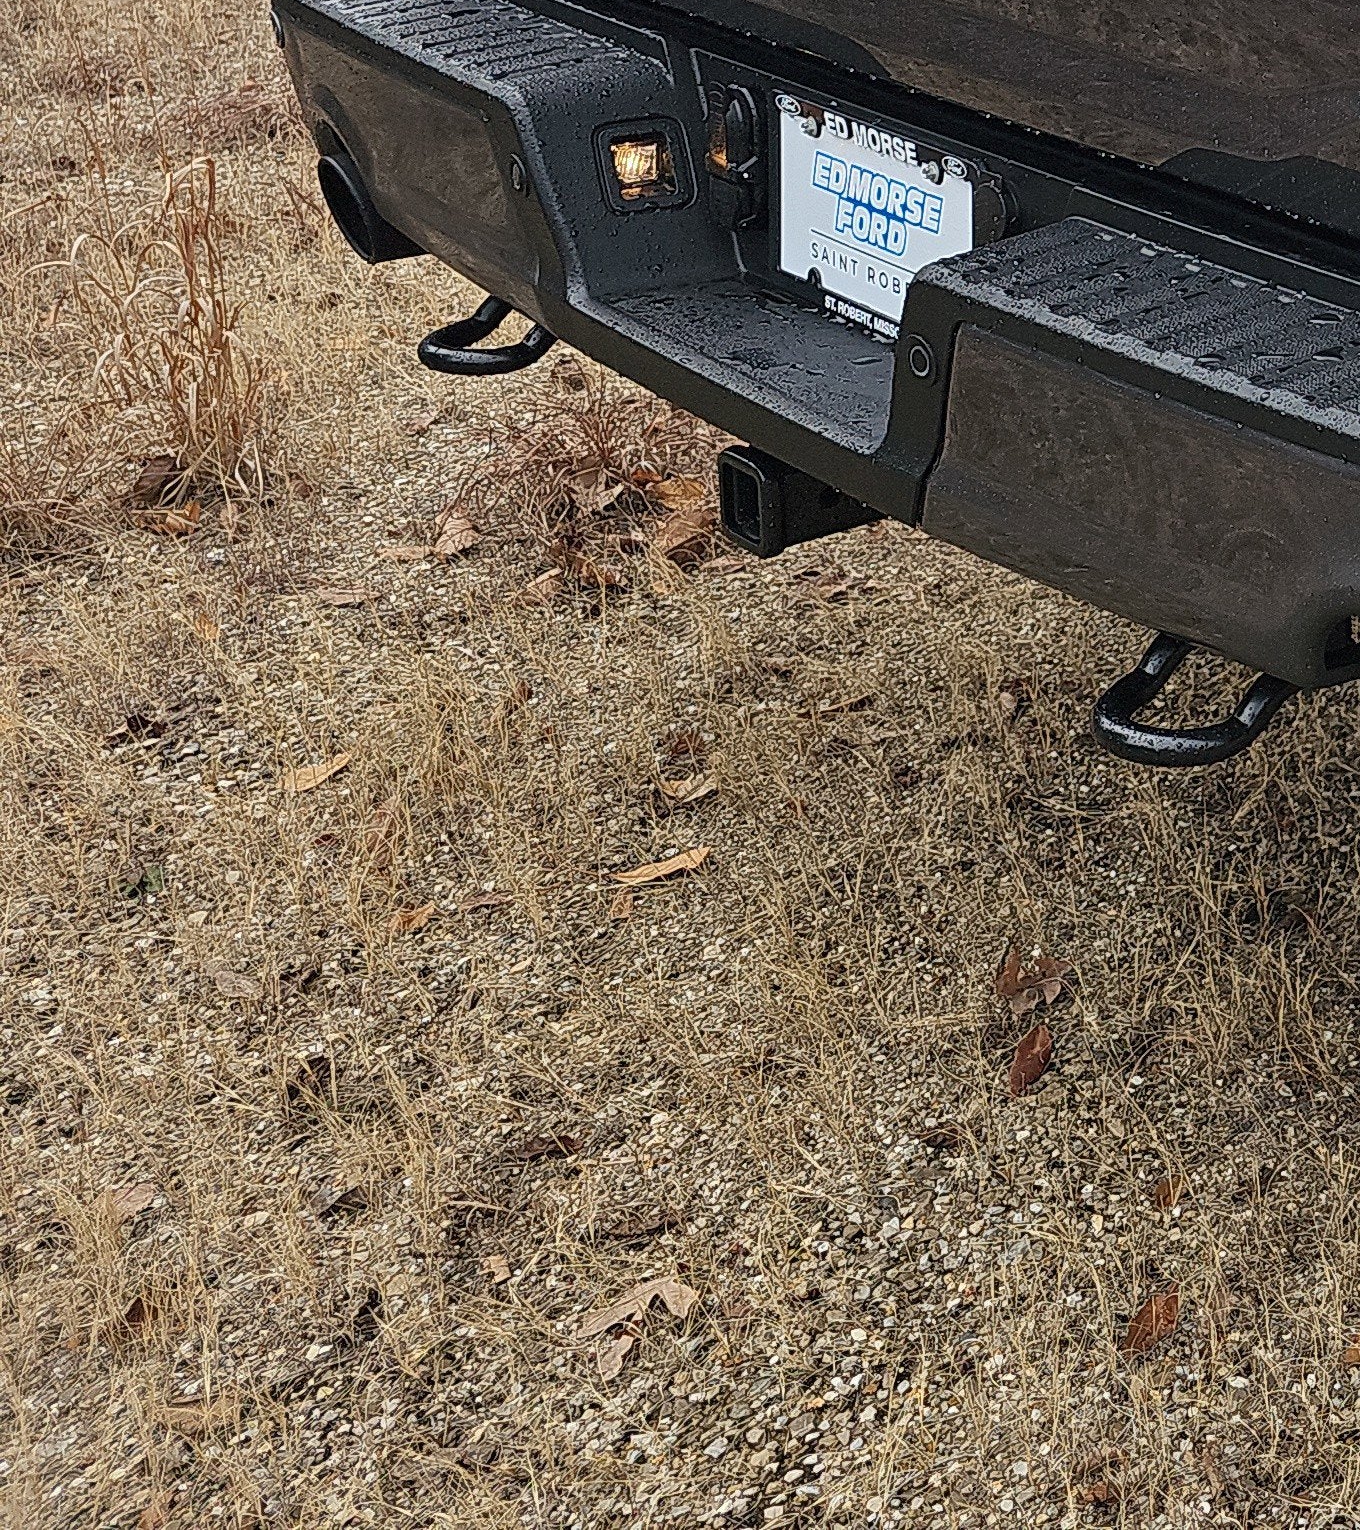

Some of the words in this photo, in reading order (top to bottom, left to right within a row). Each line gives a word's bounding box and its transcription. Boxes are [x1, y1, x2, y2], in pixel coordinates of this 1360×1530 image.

[823, 111, 849, 139] ED
[851, 122, 917, 165] MORSE
[812, 150, 849, 199] ED
[848, 165, 943, 234] MORSE
[835, 196, 907, 256] FORD
[811, 242, 859, 277] SAINT
